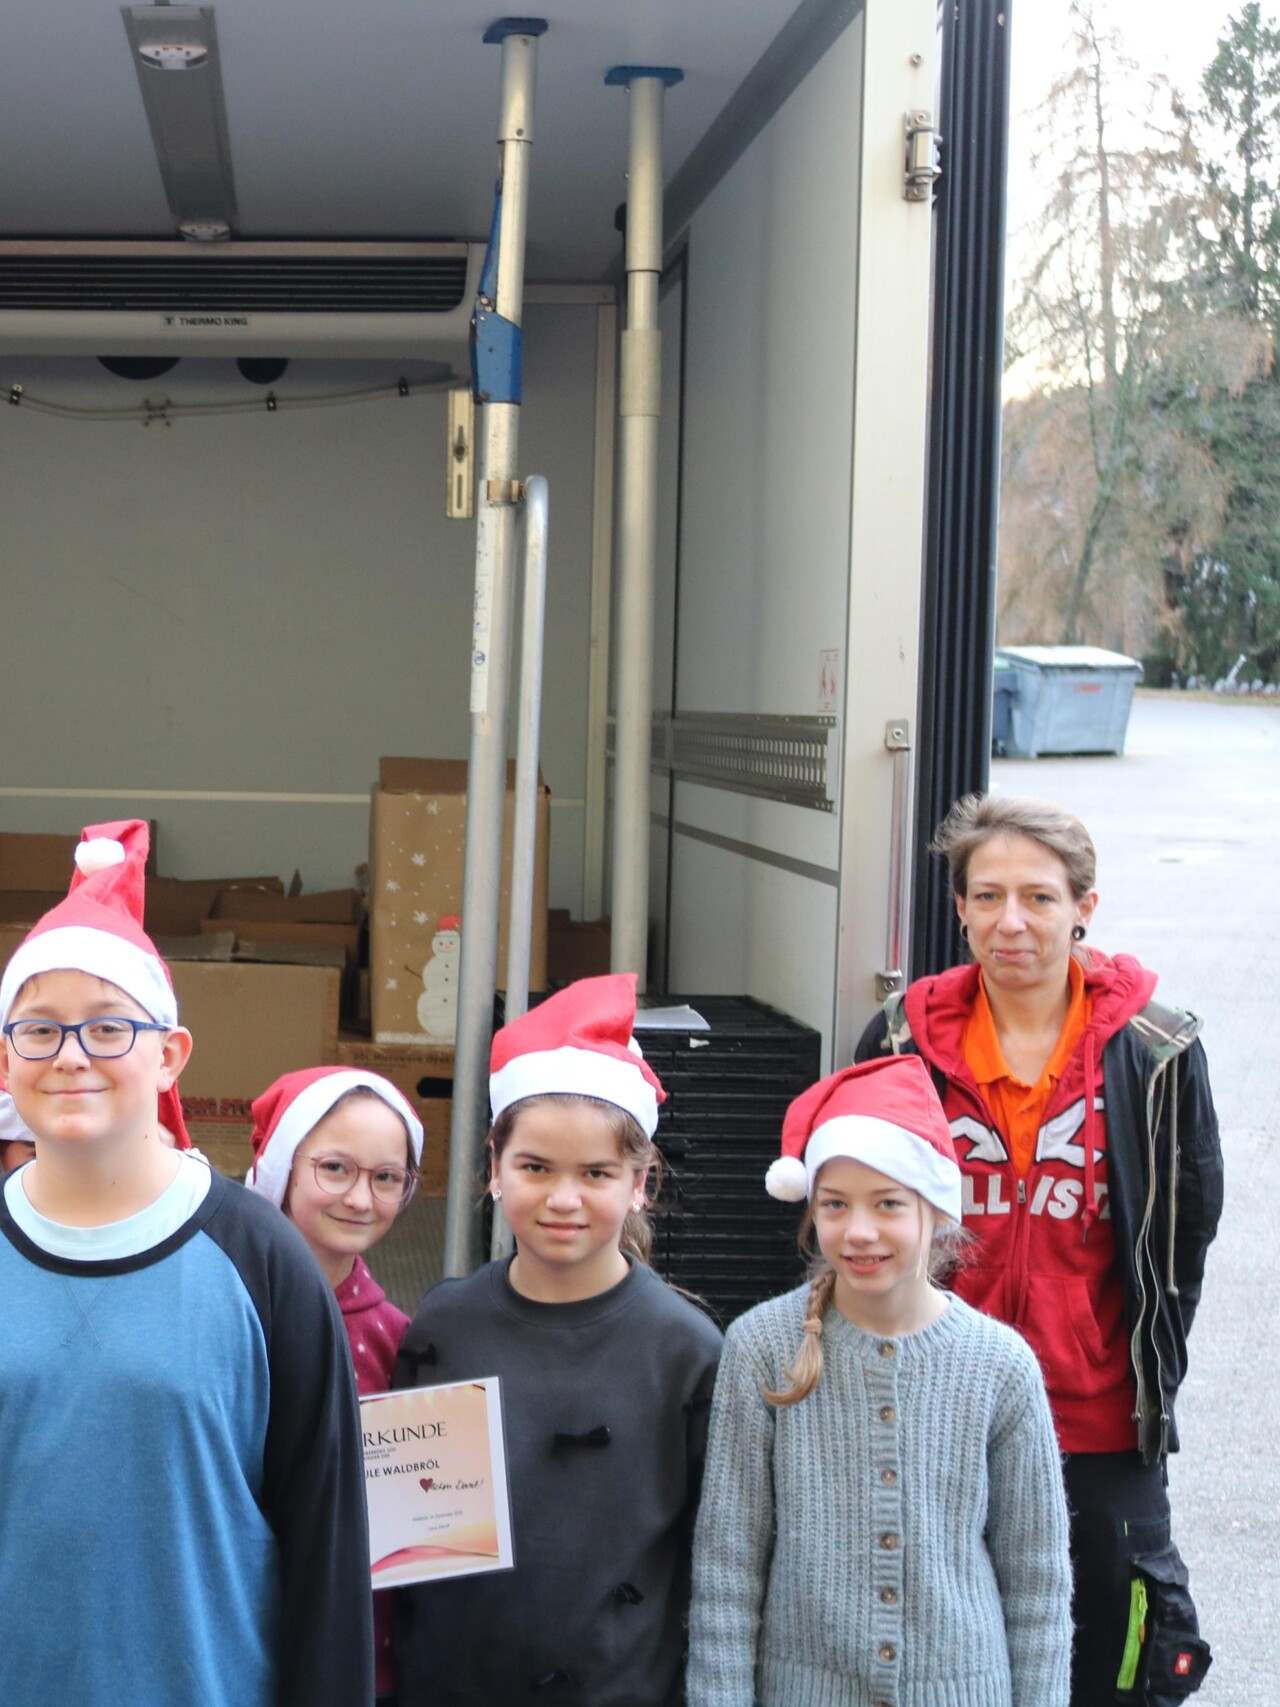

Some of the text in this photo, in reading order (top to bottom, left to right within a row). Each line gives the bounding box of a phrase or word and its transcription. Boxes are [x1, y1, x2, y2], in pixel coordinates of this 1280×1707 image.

[180, 316, 222, 326] THERMO
[224, 316, 248, 326] KING
[363, 1421, 448, 1448] RKUNDE
[383, 1459, 441, 1476] WALDBRÖL
